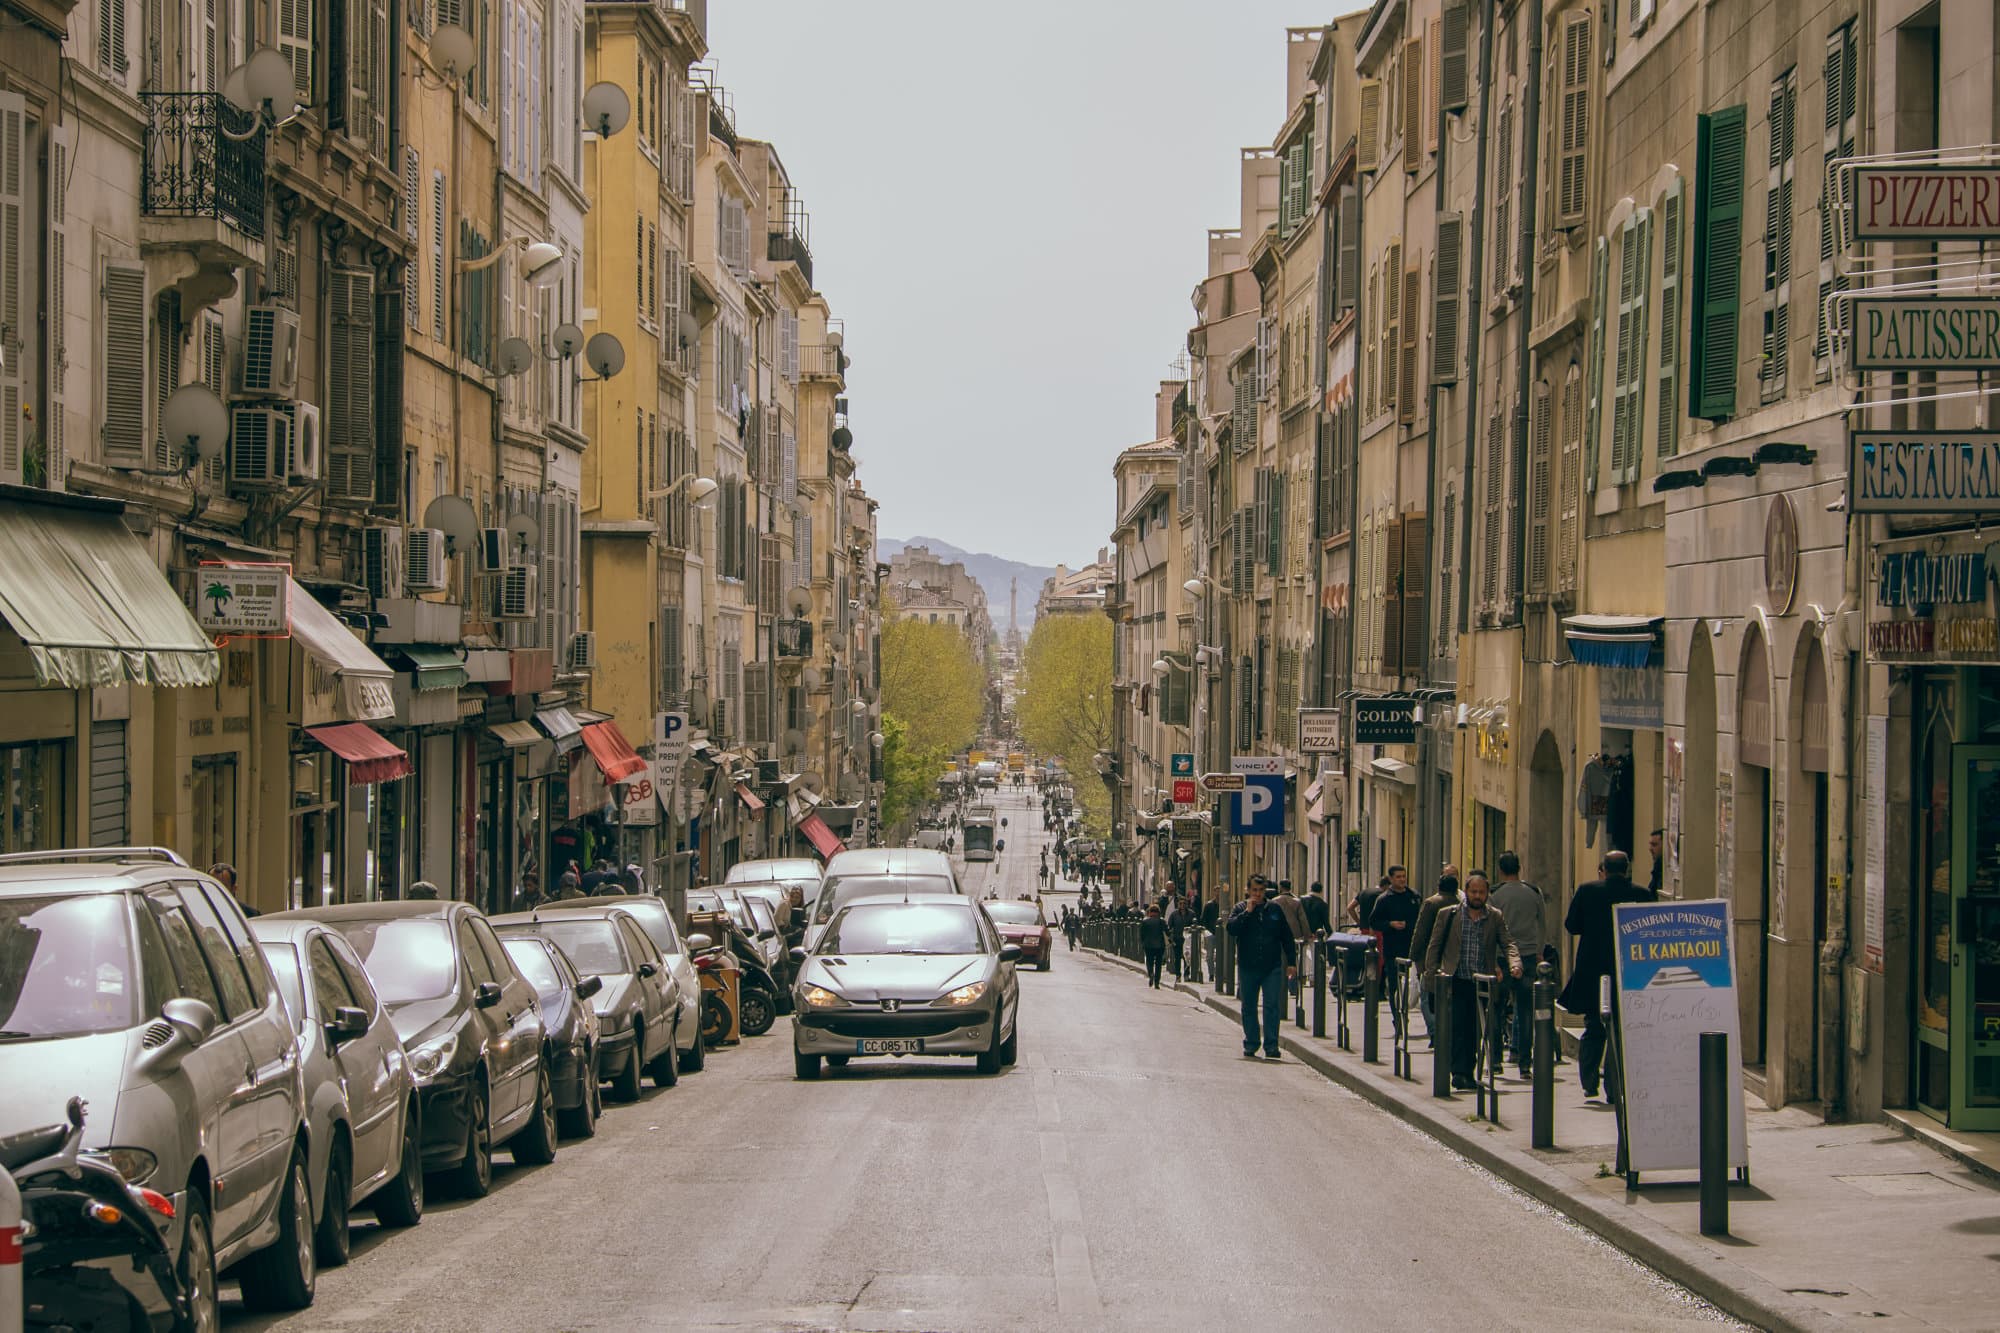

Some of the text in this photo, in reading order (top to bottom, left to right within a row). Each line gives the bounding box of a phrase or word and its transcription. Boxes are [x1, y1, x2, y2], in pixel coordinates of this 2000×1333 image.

[1867, 176, 2000, 228] PIZZER
[665, 715, 682, 739] P
[1303, 737, 1335, 747] PIZZA
[1176, 786, 1193, 798] SFR
[1241, 785, 1273, 825] P
[856, 819, 864, 829] P
[1621, 911, 1722, 935] RESTAURANT PATISSERIE
[1630, 940, 1721, 960] EL KANTAOUI
